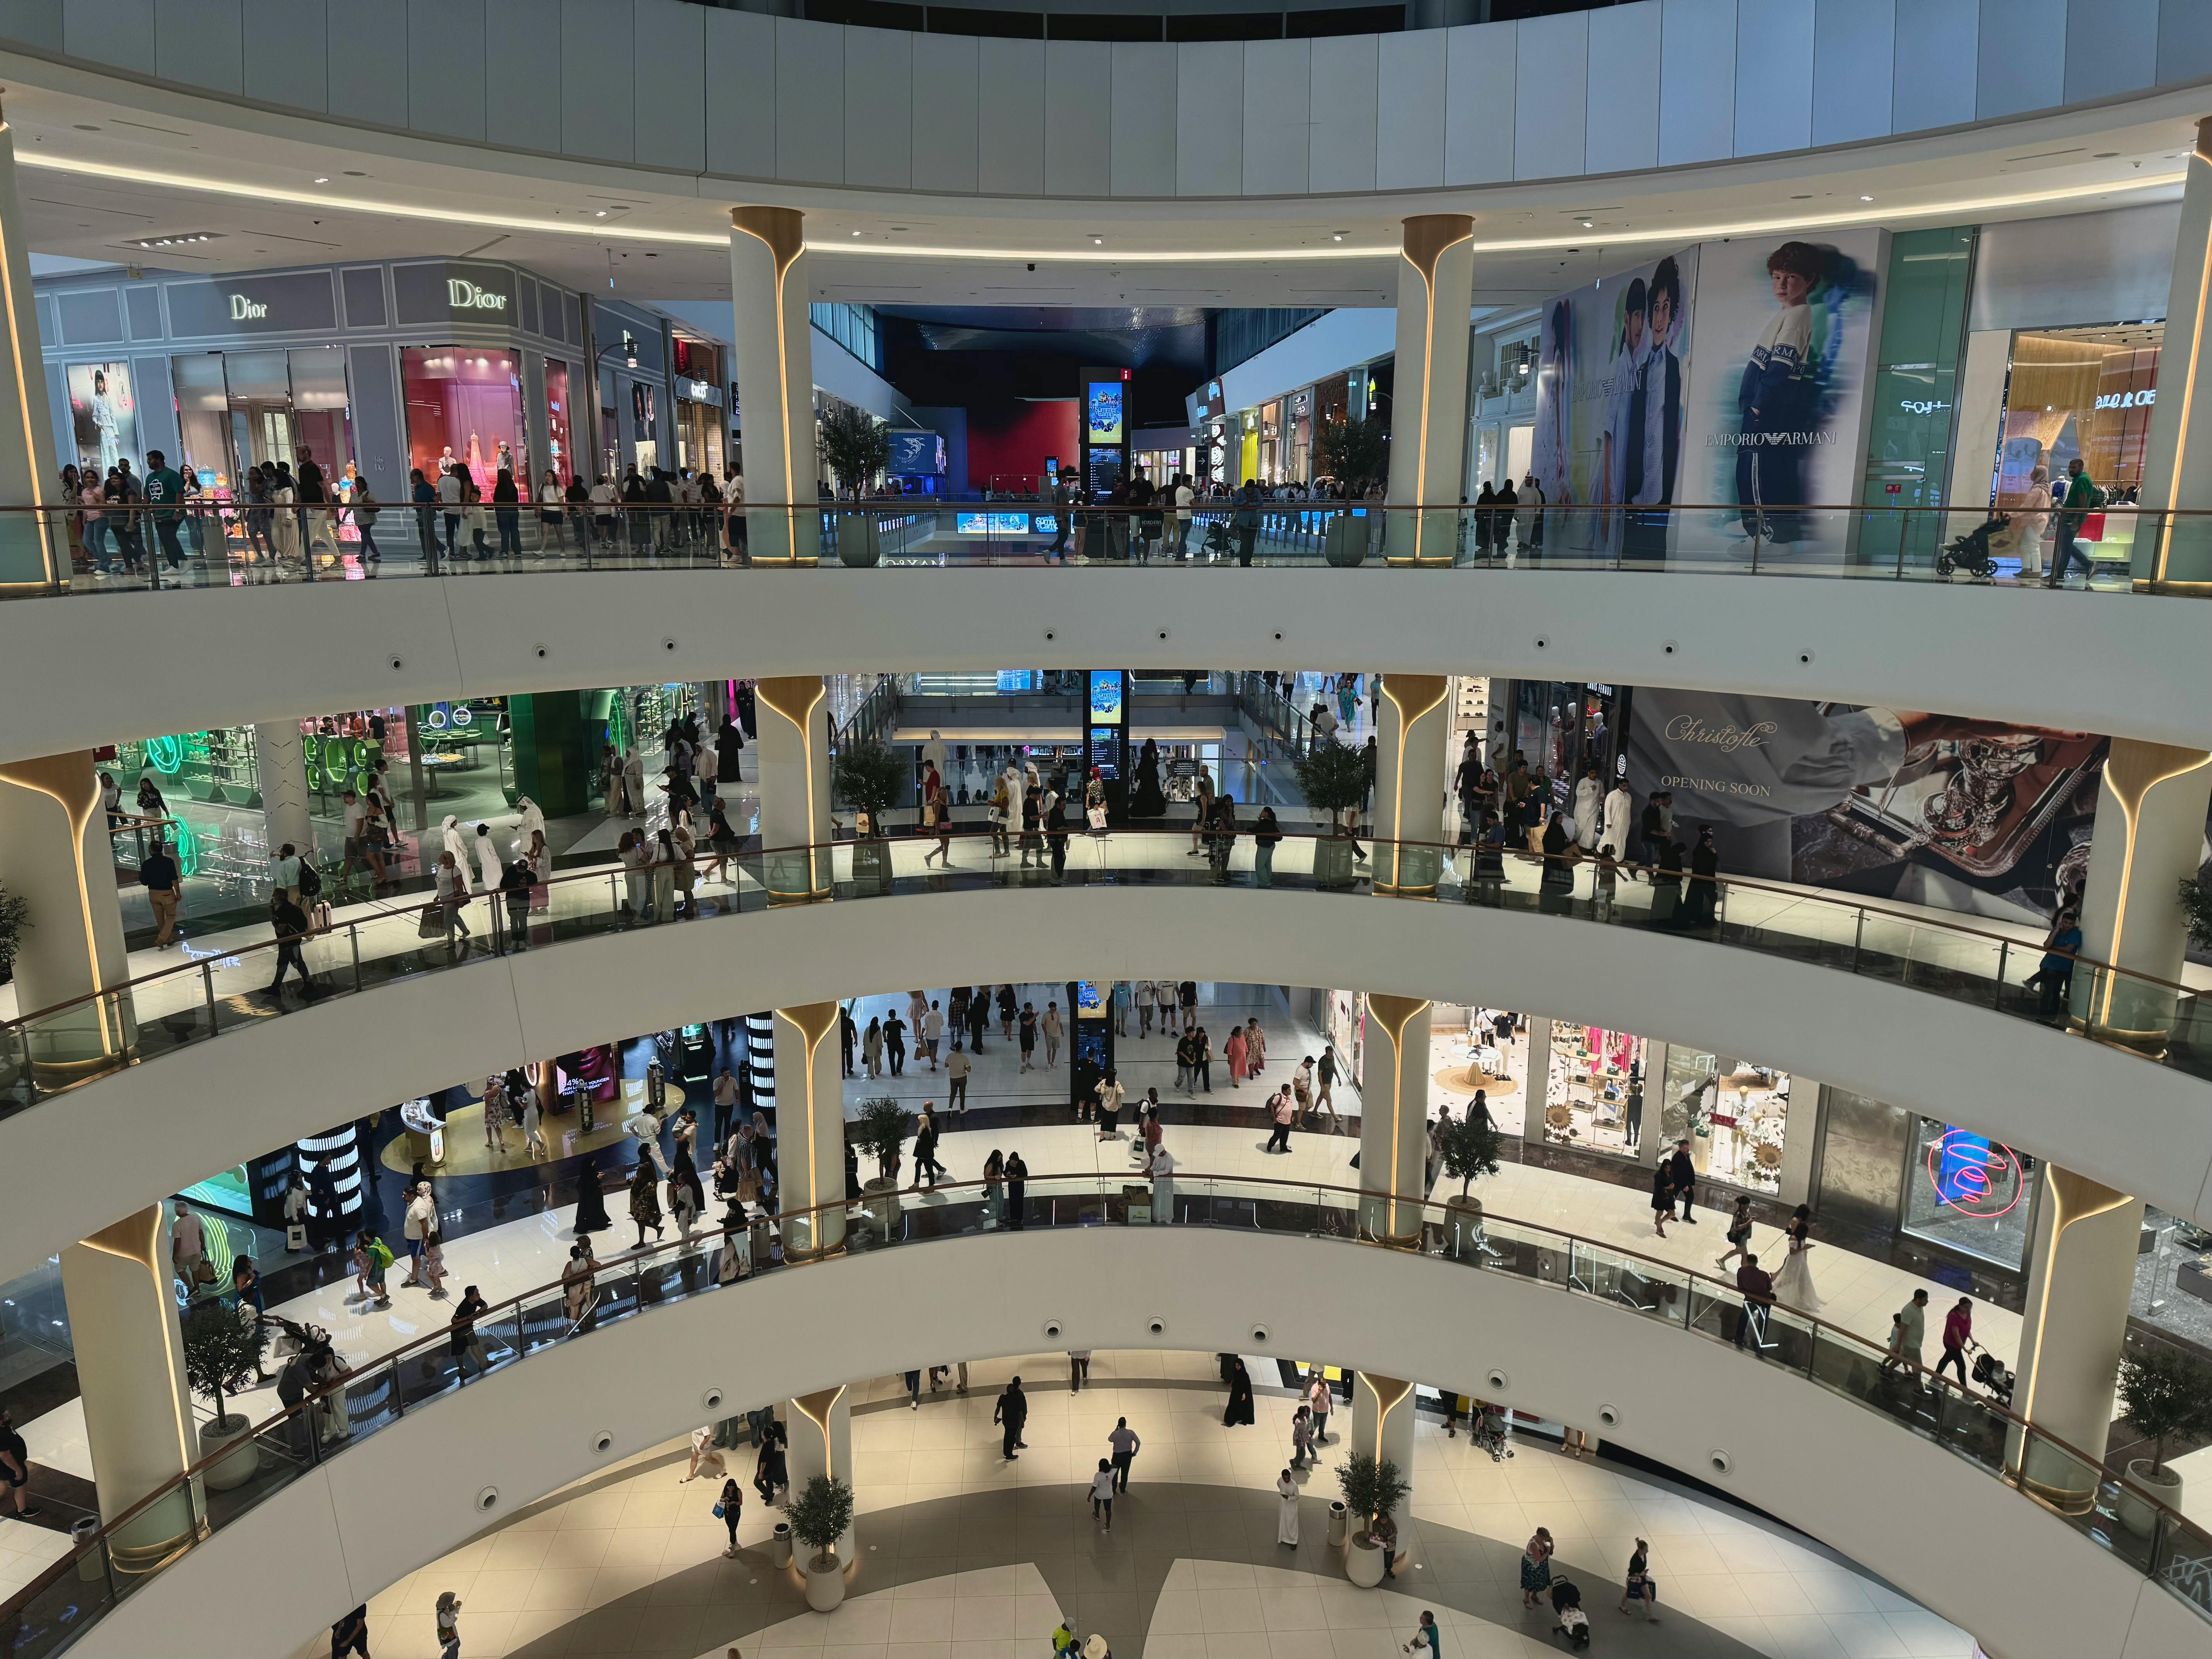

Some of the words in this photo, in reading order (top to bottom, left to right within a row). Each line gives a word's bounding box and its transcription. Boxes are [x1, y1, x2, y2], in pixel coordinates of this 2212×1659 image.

[446, 278, 507, 309] Dior
[228, 294, 267, 320] Dior
[1572, 380, 1603, 403] EMPORIO
[1610, 371, 1642, 395] ARMANI
[1705, 433, 1765, 447] EMPORIO
[1783, 431, 1837, 445] ARMANI
[1665, 715, 1778, 752] Christofle
[1661, 776, 1725, 792] OPENING
[1730, 783, 1770, 797] SOON
[561, 1078, 579, 1089] 94%
[588, 1077, 610, 1085] YOUNGER
